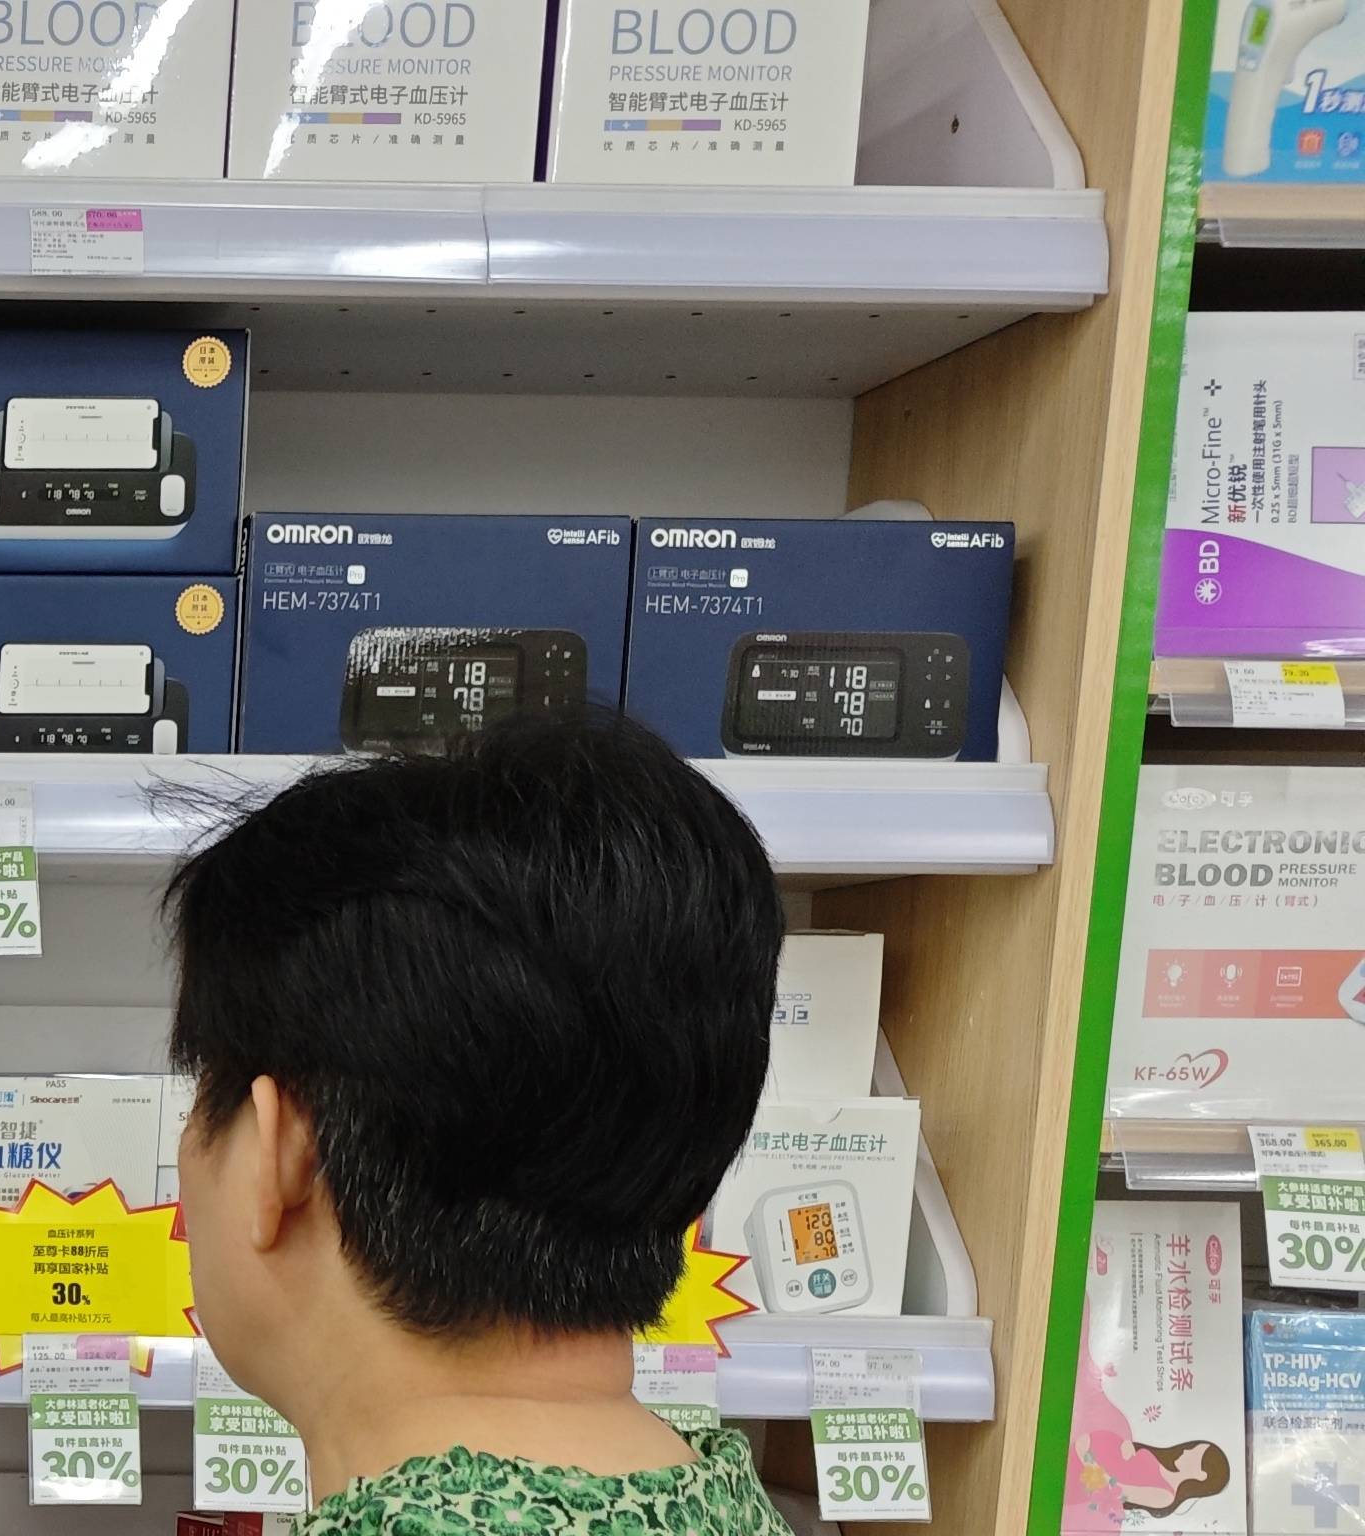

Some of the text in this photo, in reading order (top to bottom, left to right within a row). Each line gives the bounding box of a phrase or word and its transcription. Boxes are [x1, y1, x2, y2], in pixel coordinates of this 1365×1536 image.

[611, 9, 797, 56] BLOOD
[609, 65, 792, 82] PRESSURE MONITOR
[608, 91, 788, 112] 智能臂式电子血压计
[733, 119, 787, 132] KD-5965
[199, 346, 216, 355] 日本
[1253, 380, 1267, 523] 一次性使用注射笔用针头
[1202, 416, 1221, 524] Micro-Fine
[1228, 464, 1247, 523] 新优锐
[586, 529, 620, 547] AFib
[970, 532, 1004, 551] AFib
[1199, 540, 1220, 574] BD
[263, 591, 381, 611] HEM-7374T1
[646, 594, 764, 616] HEM-7374T1
[828, 666, 868, 690] 118
[834, 692, 866, 716] 78
[840, 718, 863, 736] 70
[1155, 863, 1357, 888] BLOOD PRESSURE
[1278, 877, 1339, 888] MONITOR
[1134, 1065, 1211, 1082] KF-65W
[752, 1132, 888, 1154] 臂式电子血压计
[1259, 1138, 1347, 1148] 368.00 365.00
[805, 1212, 832, 1230] 120
[1166, 1233, 1193, 1392] 羊水检测试条
[1263, 1354, 1327, 1369] TP-HIV-
[1263, 1371, 1361, 1390] HBsAg-HCV
[205, 1457, 304, 1497] 30%
[826, 1465, 925, 1502] 30%
